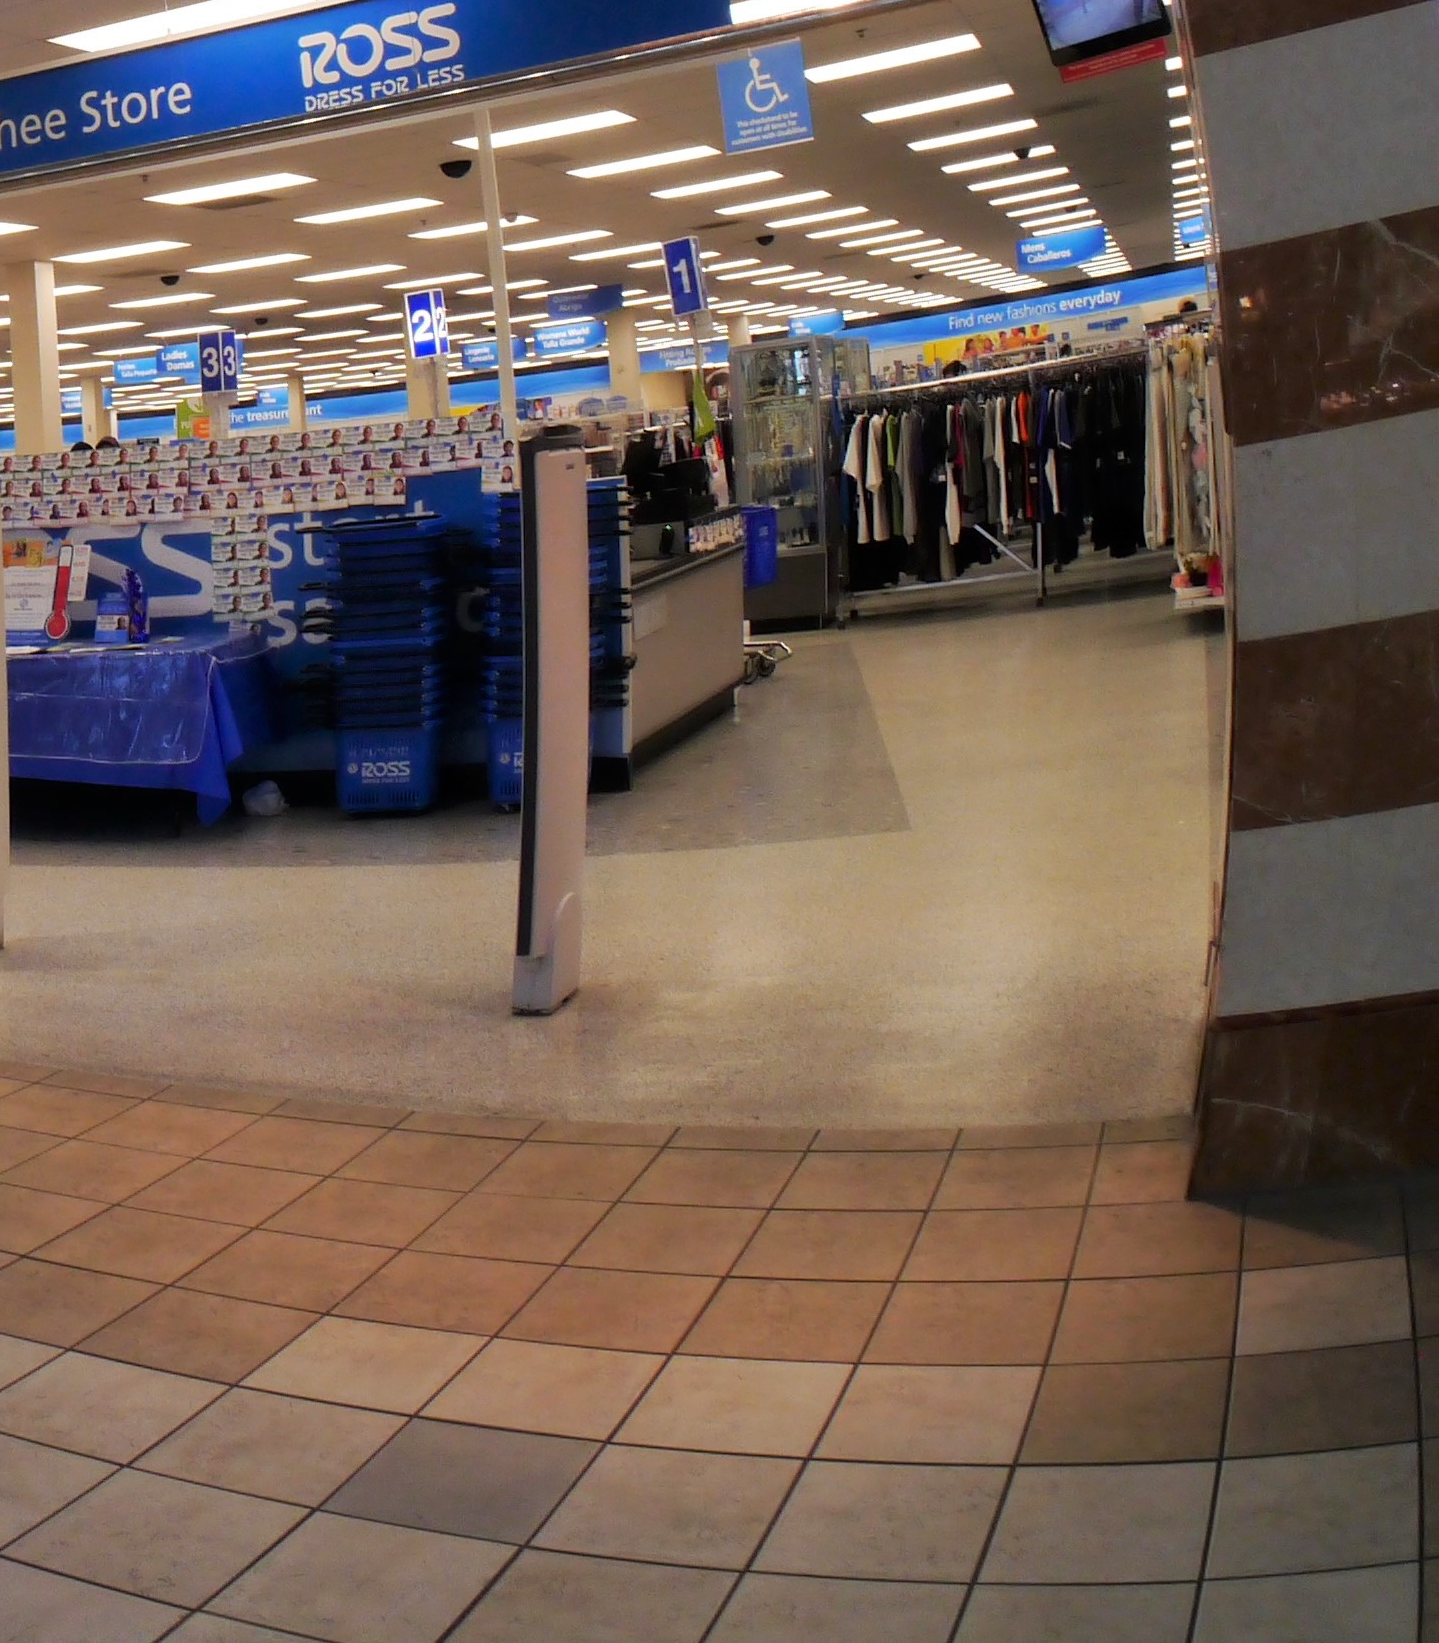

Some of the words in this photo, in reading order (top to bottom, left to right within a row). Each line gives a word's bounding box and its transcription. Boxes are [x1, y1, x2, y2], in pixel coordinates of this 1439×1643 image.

[298, 3, 461, 88] ROSS
[305, 85, 364, 112] DRESS
[371, 76, 409, 99] FOR
[417, 64, 465, 88] LESS
[82, 80, 193, 135] Store
[1021, 242, 1046, 254] Mens
[672, 259, 691, 294] 1
[412, 309, 434, 343] 2
[436, 306, 448, 339] 2
[948, 315, 974, 330] Find
[977, 312, 1004, 325] new
[1007, 302, 1056, 321] fashions
[1059, 290, 1121, 310] everyday
[161, 350, 189, 361] Ladies
[166, 360, 195, 371] Damas
[202, 346, 220, 378] 3
[224, 345, 235, 377] 3
[361, 761, 410, 778] ROSS
